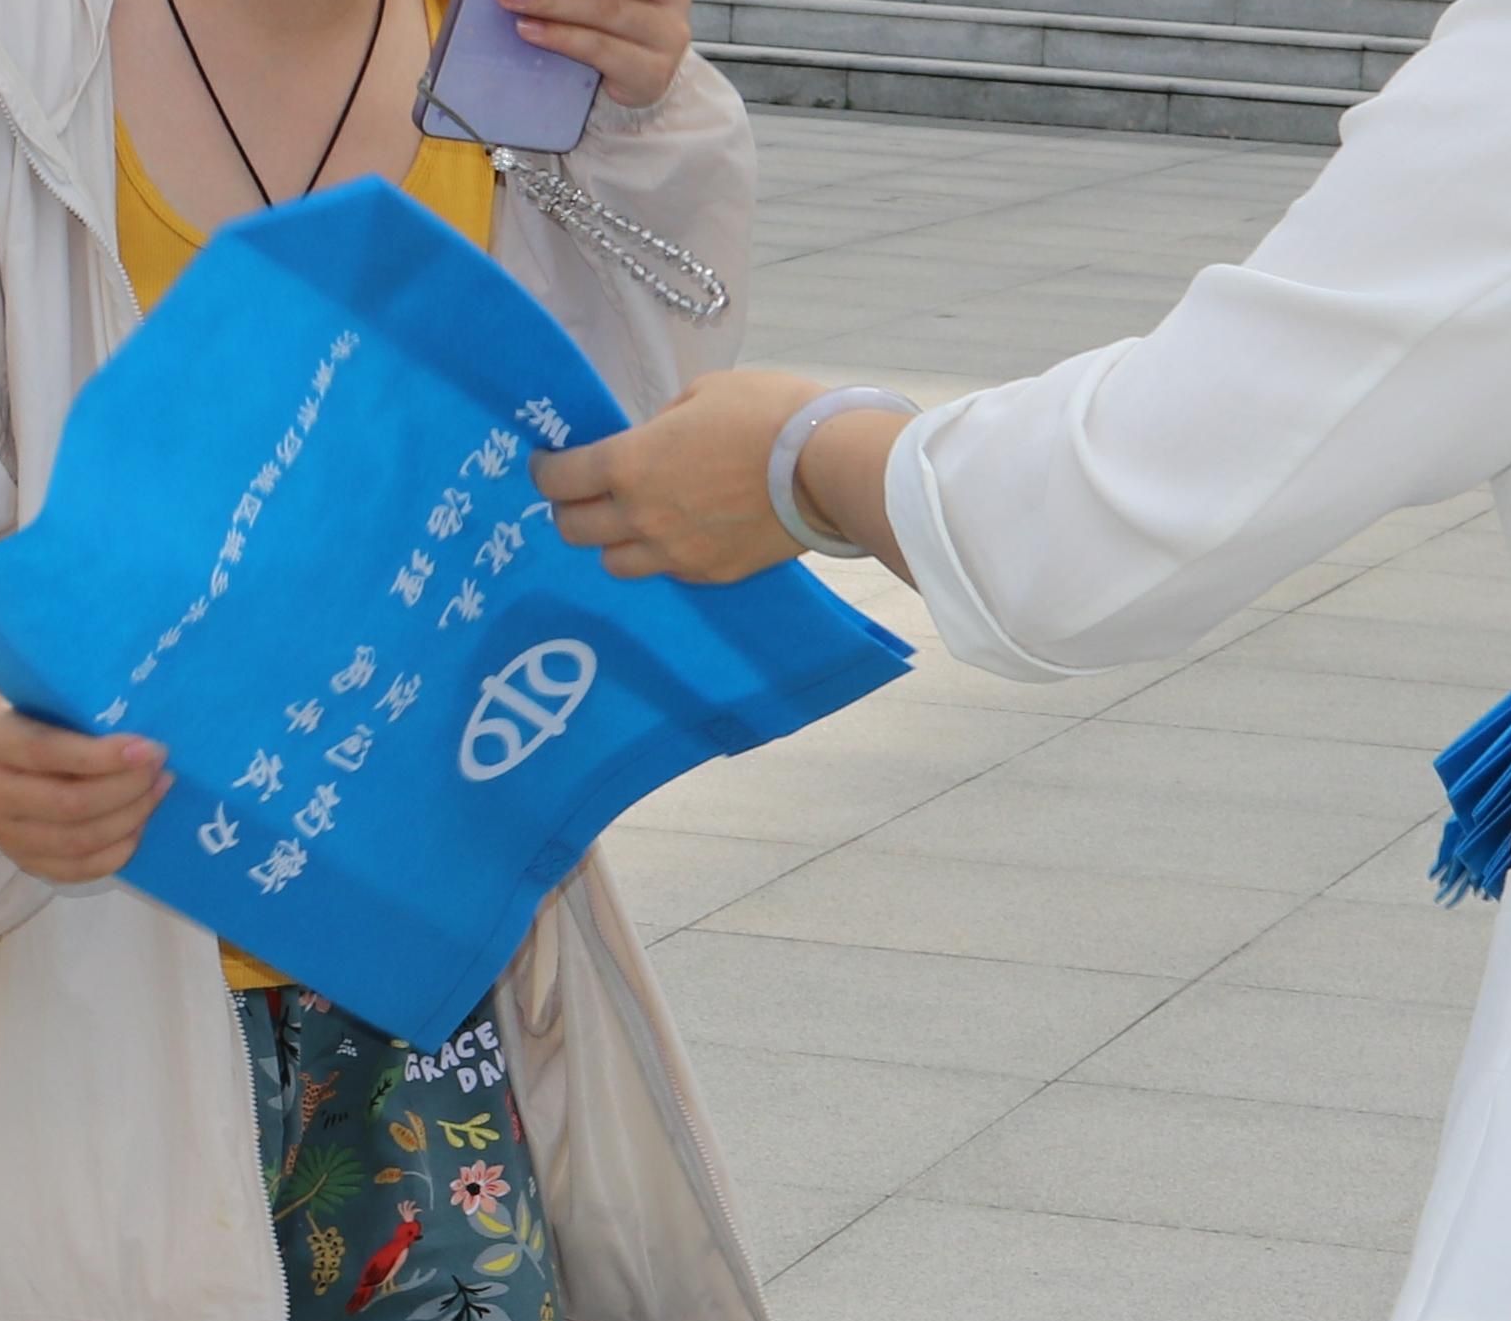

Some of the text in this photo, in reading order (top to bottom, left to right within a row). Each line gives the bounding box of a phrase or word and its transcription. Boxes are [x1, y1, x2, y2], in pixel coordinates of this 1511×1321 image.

[197, 395, 570, 855] 系统治理 两手发力
[248, 673, 421, 894] 空间均衡
[404, 1021, 499, 1082] GRACE
